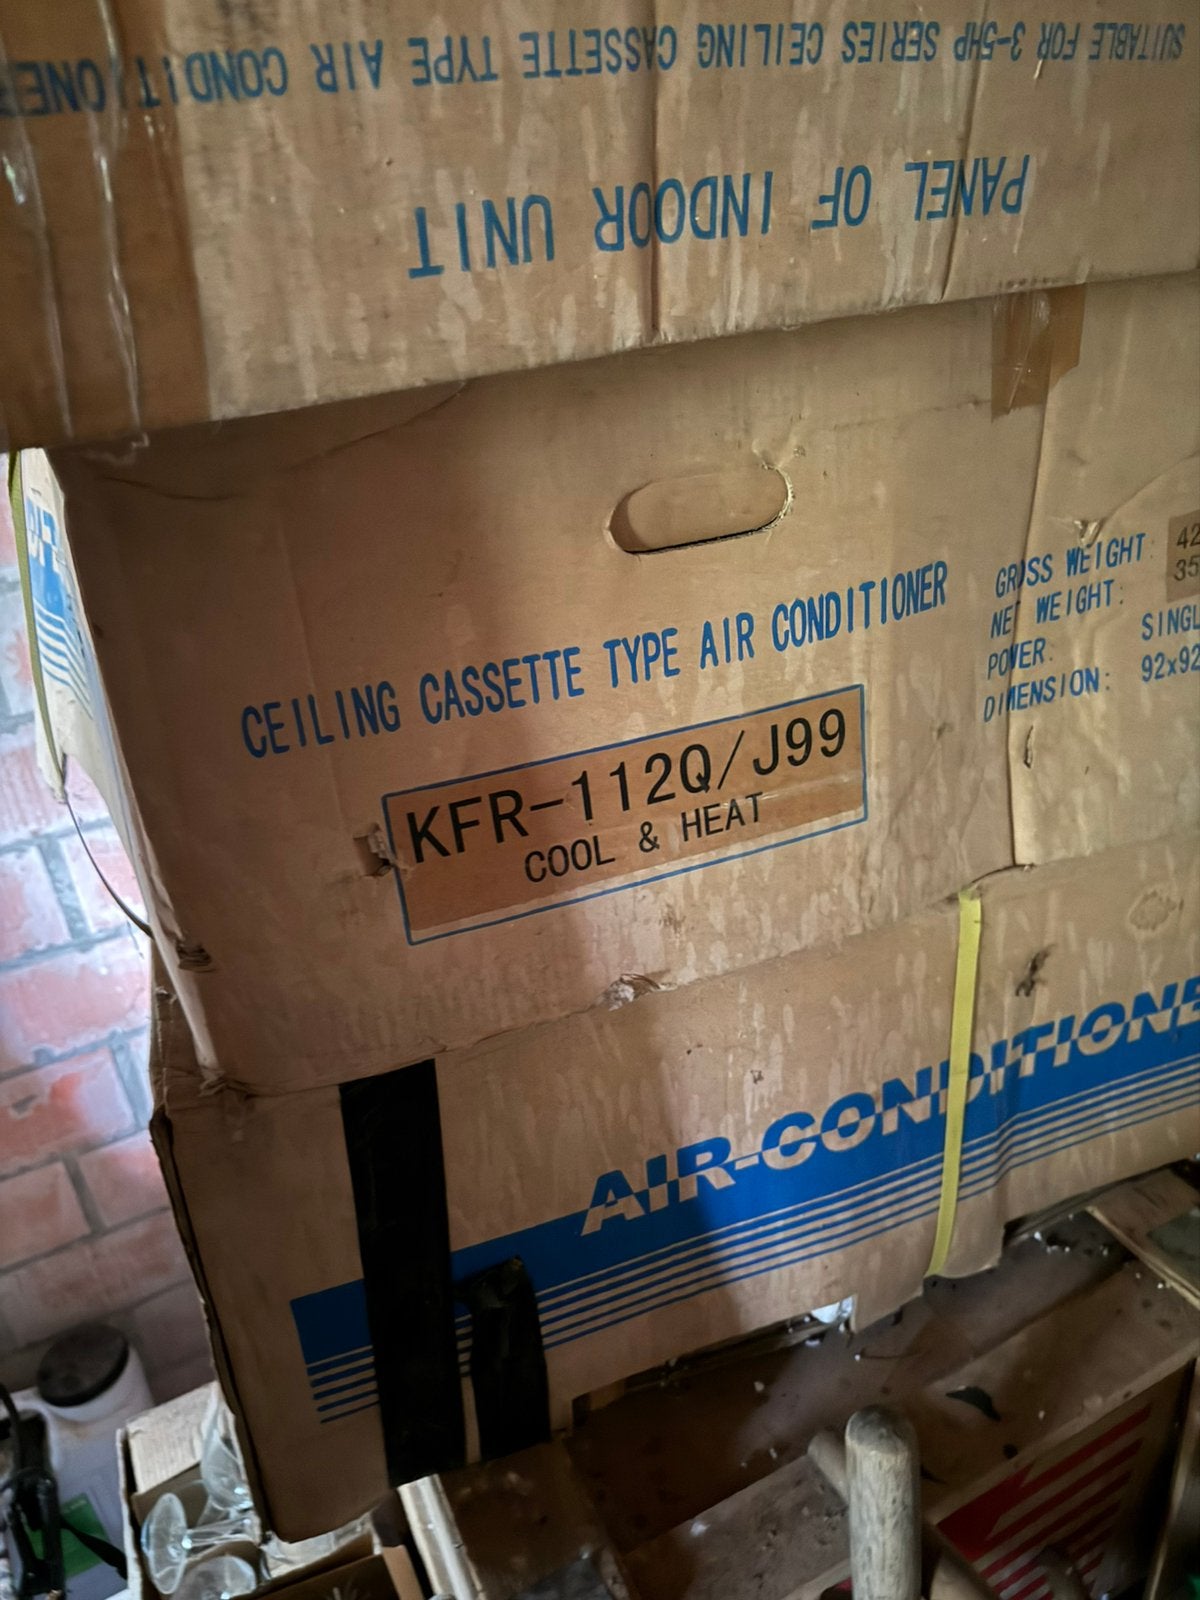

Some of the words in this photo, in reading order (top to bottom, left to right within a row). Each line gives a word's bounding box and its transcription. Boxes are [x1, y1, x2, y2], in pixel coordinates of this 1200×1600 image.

[310, 39, 384, 93] AIR
[408, 35, 499, 86] TYPE
[519, 25, 678, 79] CASSETTE
[697, 22, 825, 69] CEILING
[842, 20, 940, 64] SERIES
[953, 21, 1026, 62] 3-5HP
[1037, 21, 1081, 61] FOR
[593, 170, 774, 253] INDOOR
[811, 164, 872, 230] OF
[904, 154, 1031, 222] PANEL
[407, 194, 555, 279] UNIT
[1036, 579, 1124, 624] WEIGHT:
[241, 680, 401, 758] CEILING
[419, 646, 585, 725] CASSETTE
[603, 627, 681, 689] TYPE
[700, 612, 755, 670] AIR
[771, 560, 948, 652] CONDITIONER
[406, 708, 847, 864] KFR-112Q/J99
[524, 835, 616, 883] COOL
[638, 821, 660, 853] &
[680, 791, 764, 842] HEAT
